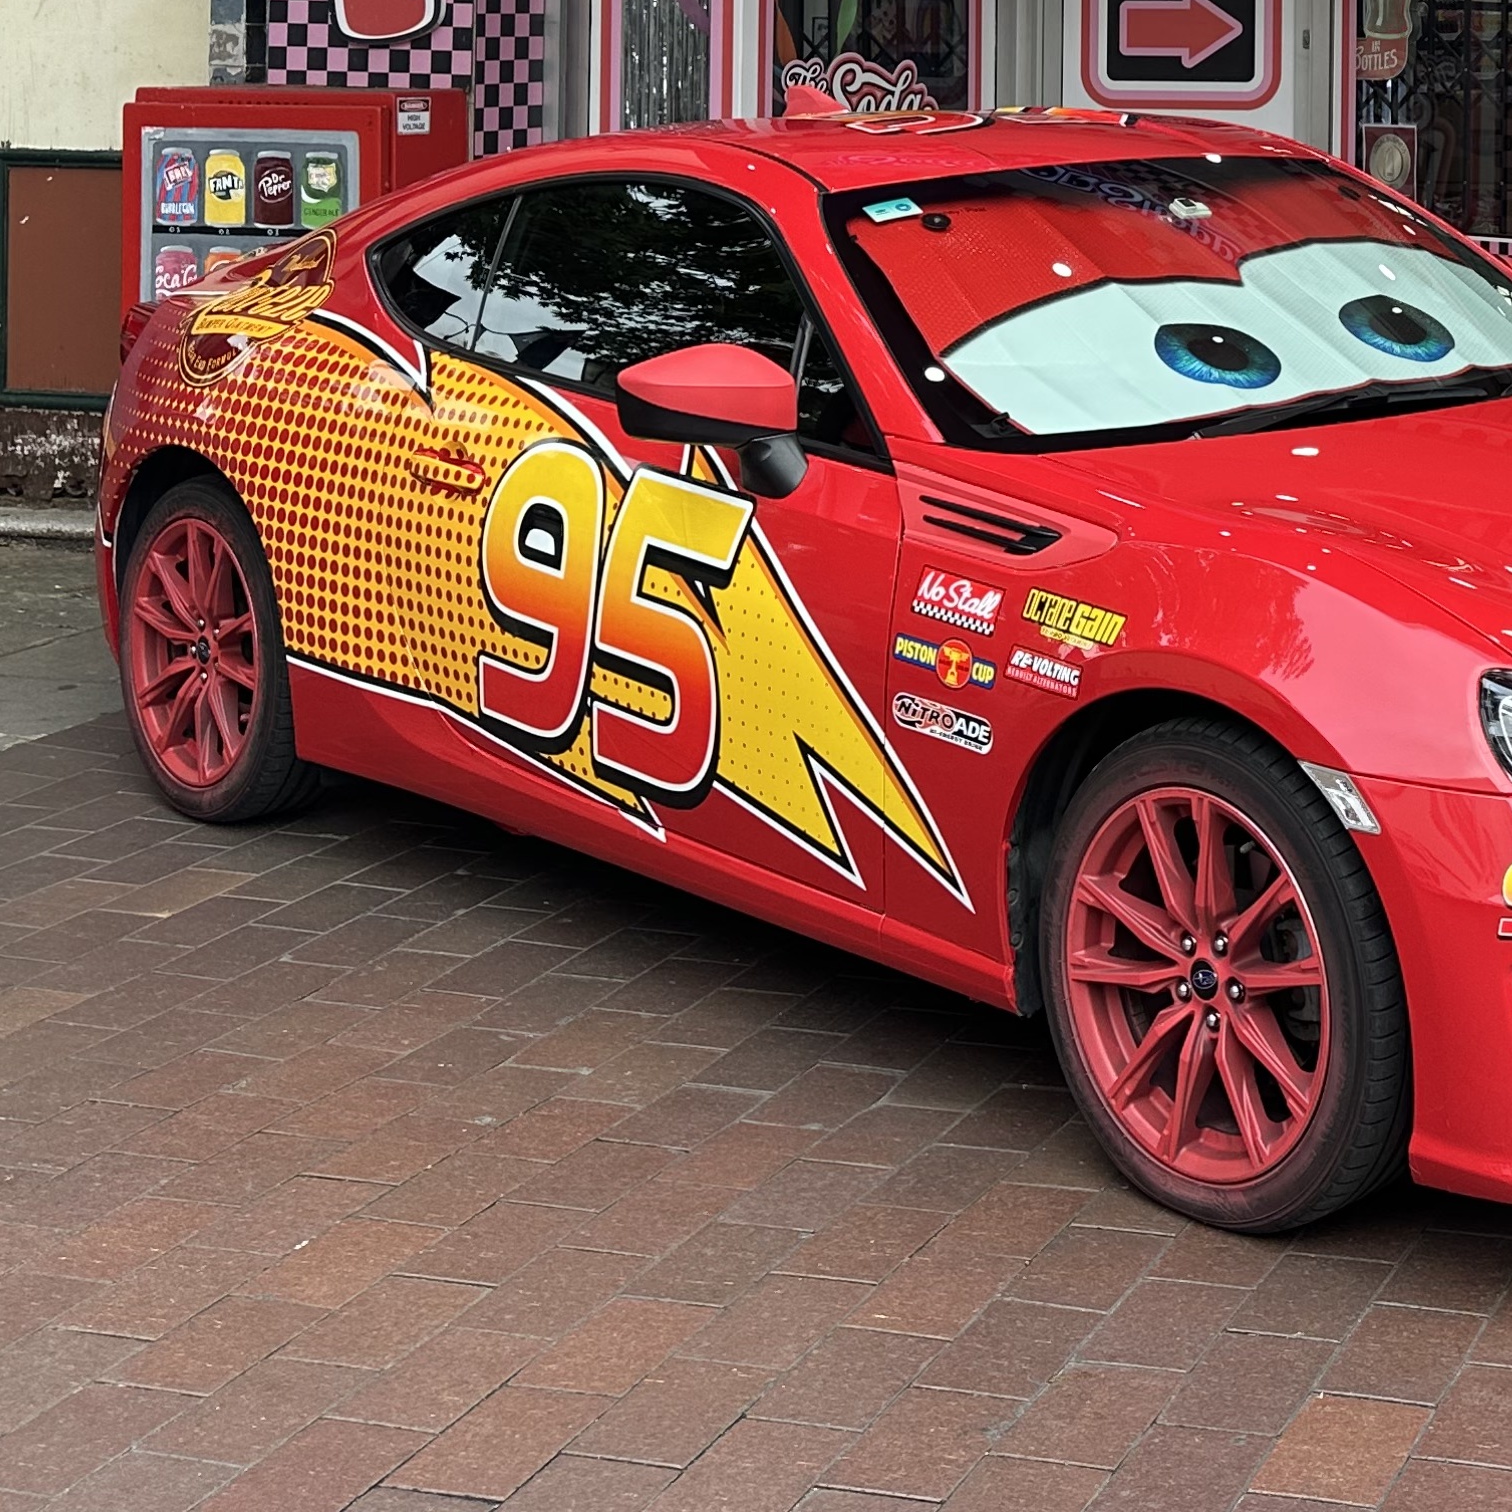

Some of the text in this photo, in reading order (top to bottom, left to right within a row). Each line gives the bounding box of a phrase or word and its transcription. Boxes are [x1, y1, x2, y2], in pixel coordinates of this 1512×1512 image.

[271, 173, 286, 184] Dr
[477, 440, 756, 798] 95
[917, 570, 1003, 620] No Stall
[894, 635, 995, 684] PISTON CUP
[1032, 674, 1079, 698] ALTERNATORS
